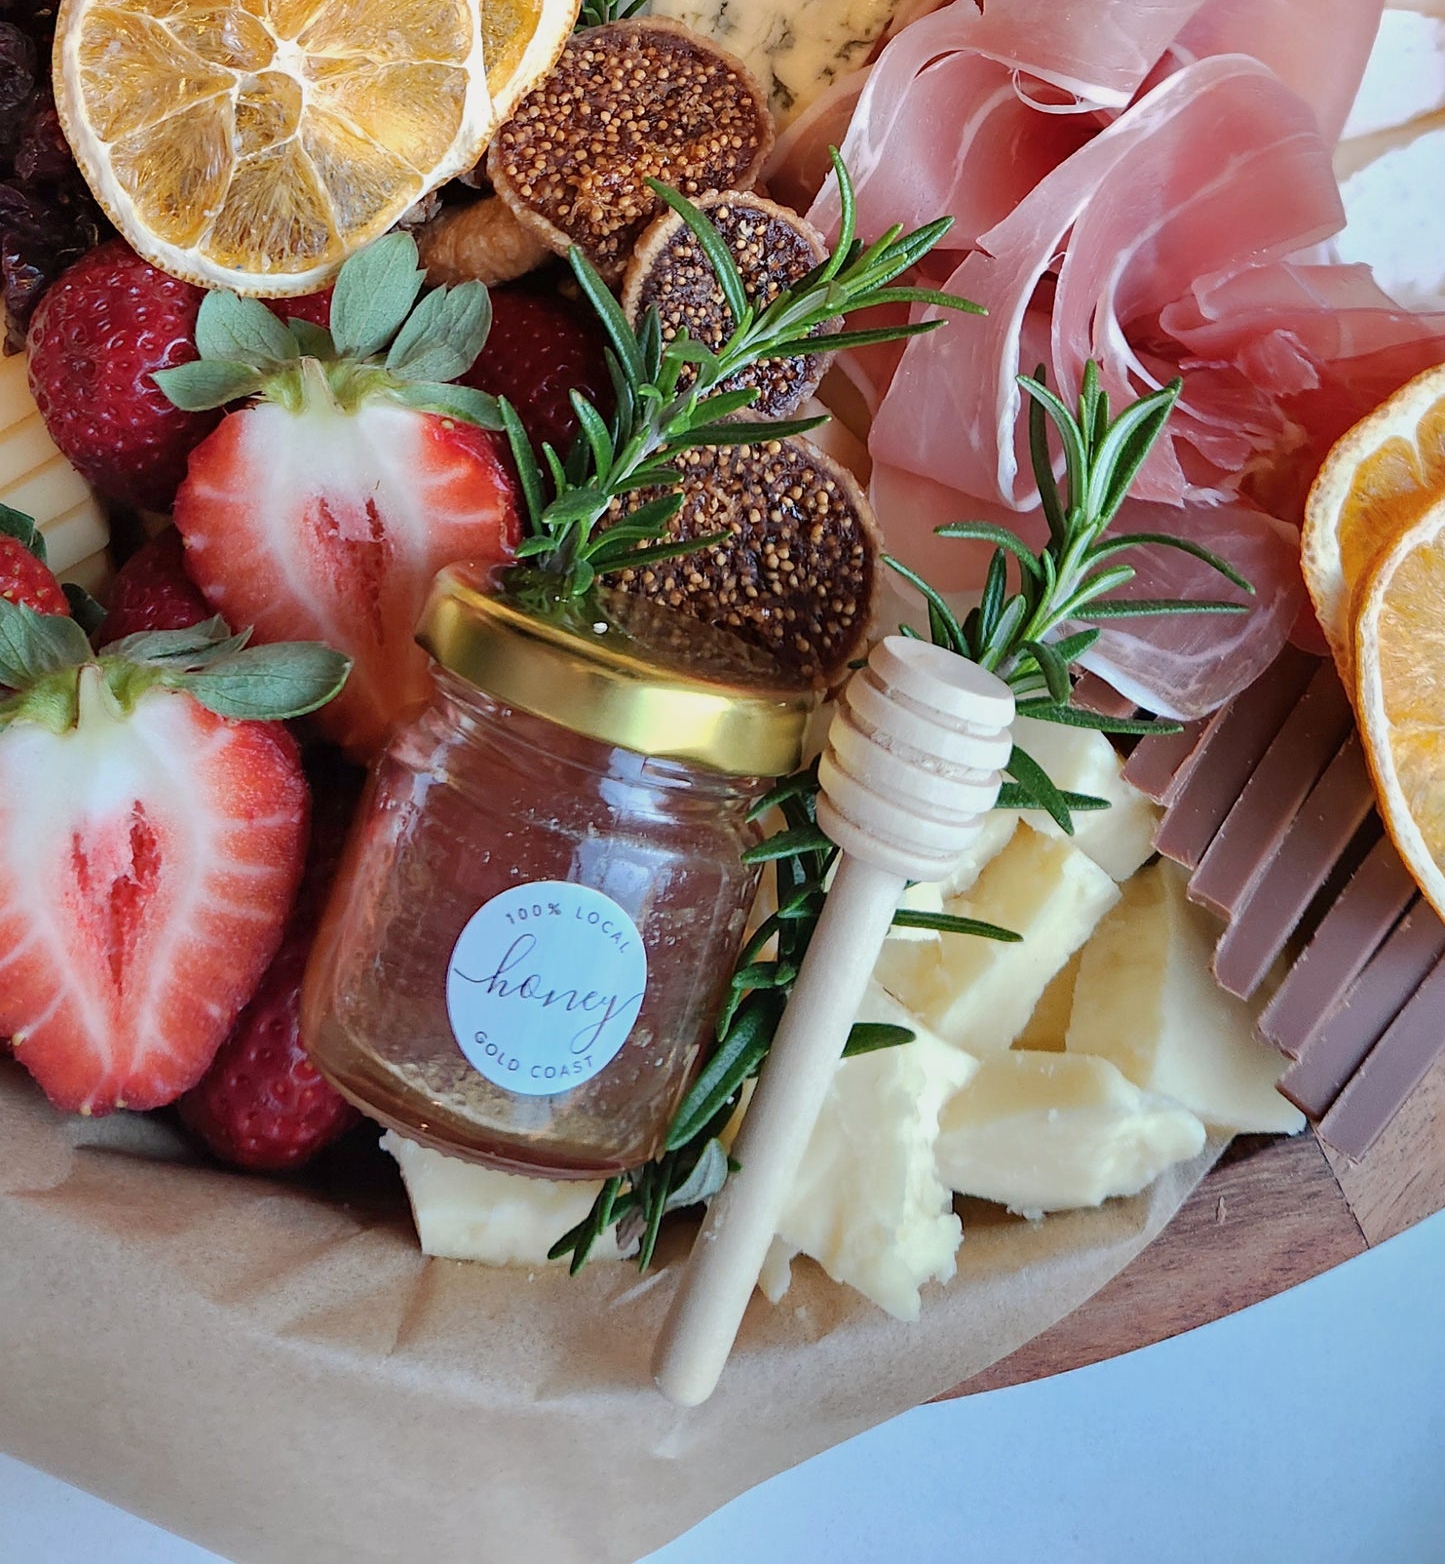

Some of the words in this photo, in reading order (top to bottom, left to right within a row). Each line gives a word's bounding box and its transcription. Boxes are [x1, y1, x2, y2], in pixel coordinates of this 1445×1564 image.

[505, 902, 562, 925] 100%
[575, 906, 632, 954] LOCAL
[454, 933, 645, 1055] honey
[474, 1030, 520, 1071] GOLD
[530, 1054, 593, 1079] COAST
